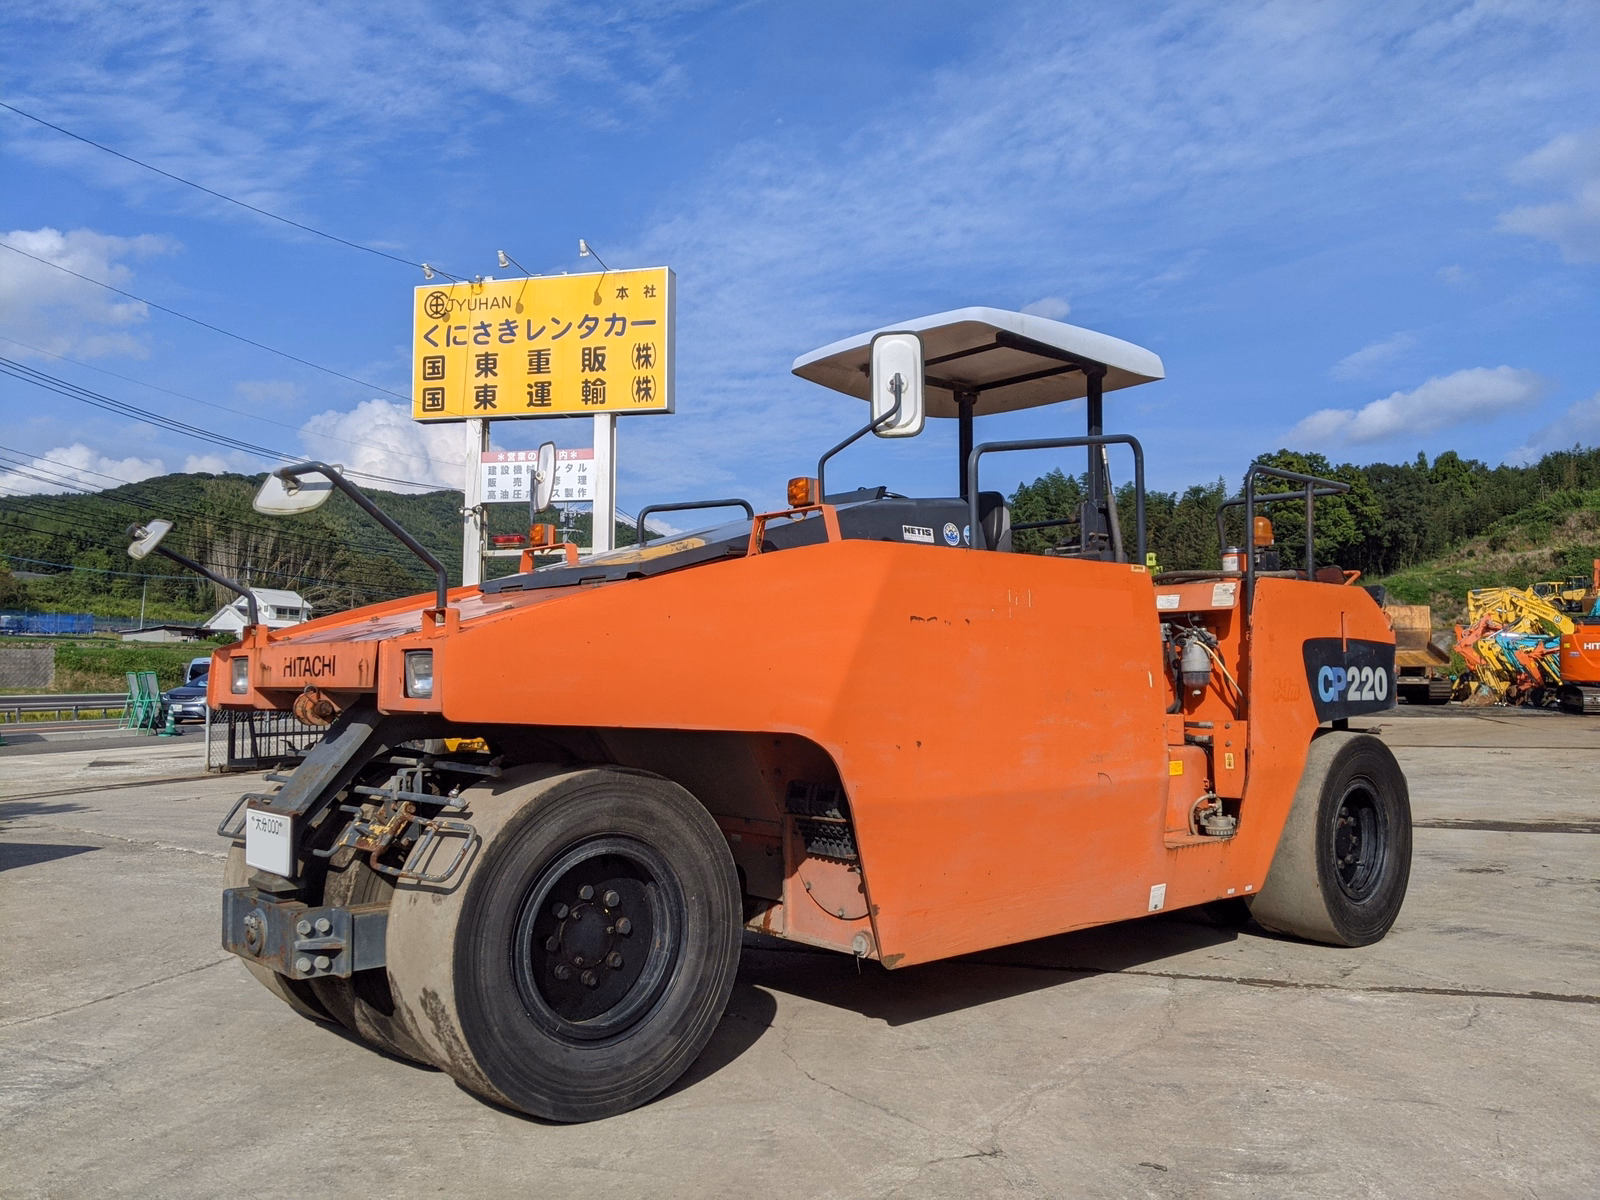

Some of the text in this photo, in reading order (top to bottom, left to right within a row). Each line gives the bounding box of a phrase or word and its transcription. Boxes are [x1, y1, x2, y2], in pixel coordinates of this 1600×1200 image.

[616, 284, 657, 300] 本社
[445, 295, 512, 312] JYUHAN
[423, 312, 657, 347] くにさきレンタカー
[903, 526, 932, 537] NETIS
[283, 655, 336, 677] HITACHI
[1317, 665, 1388, 703] CP220
